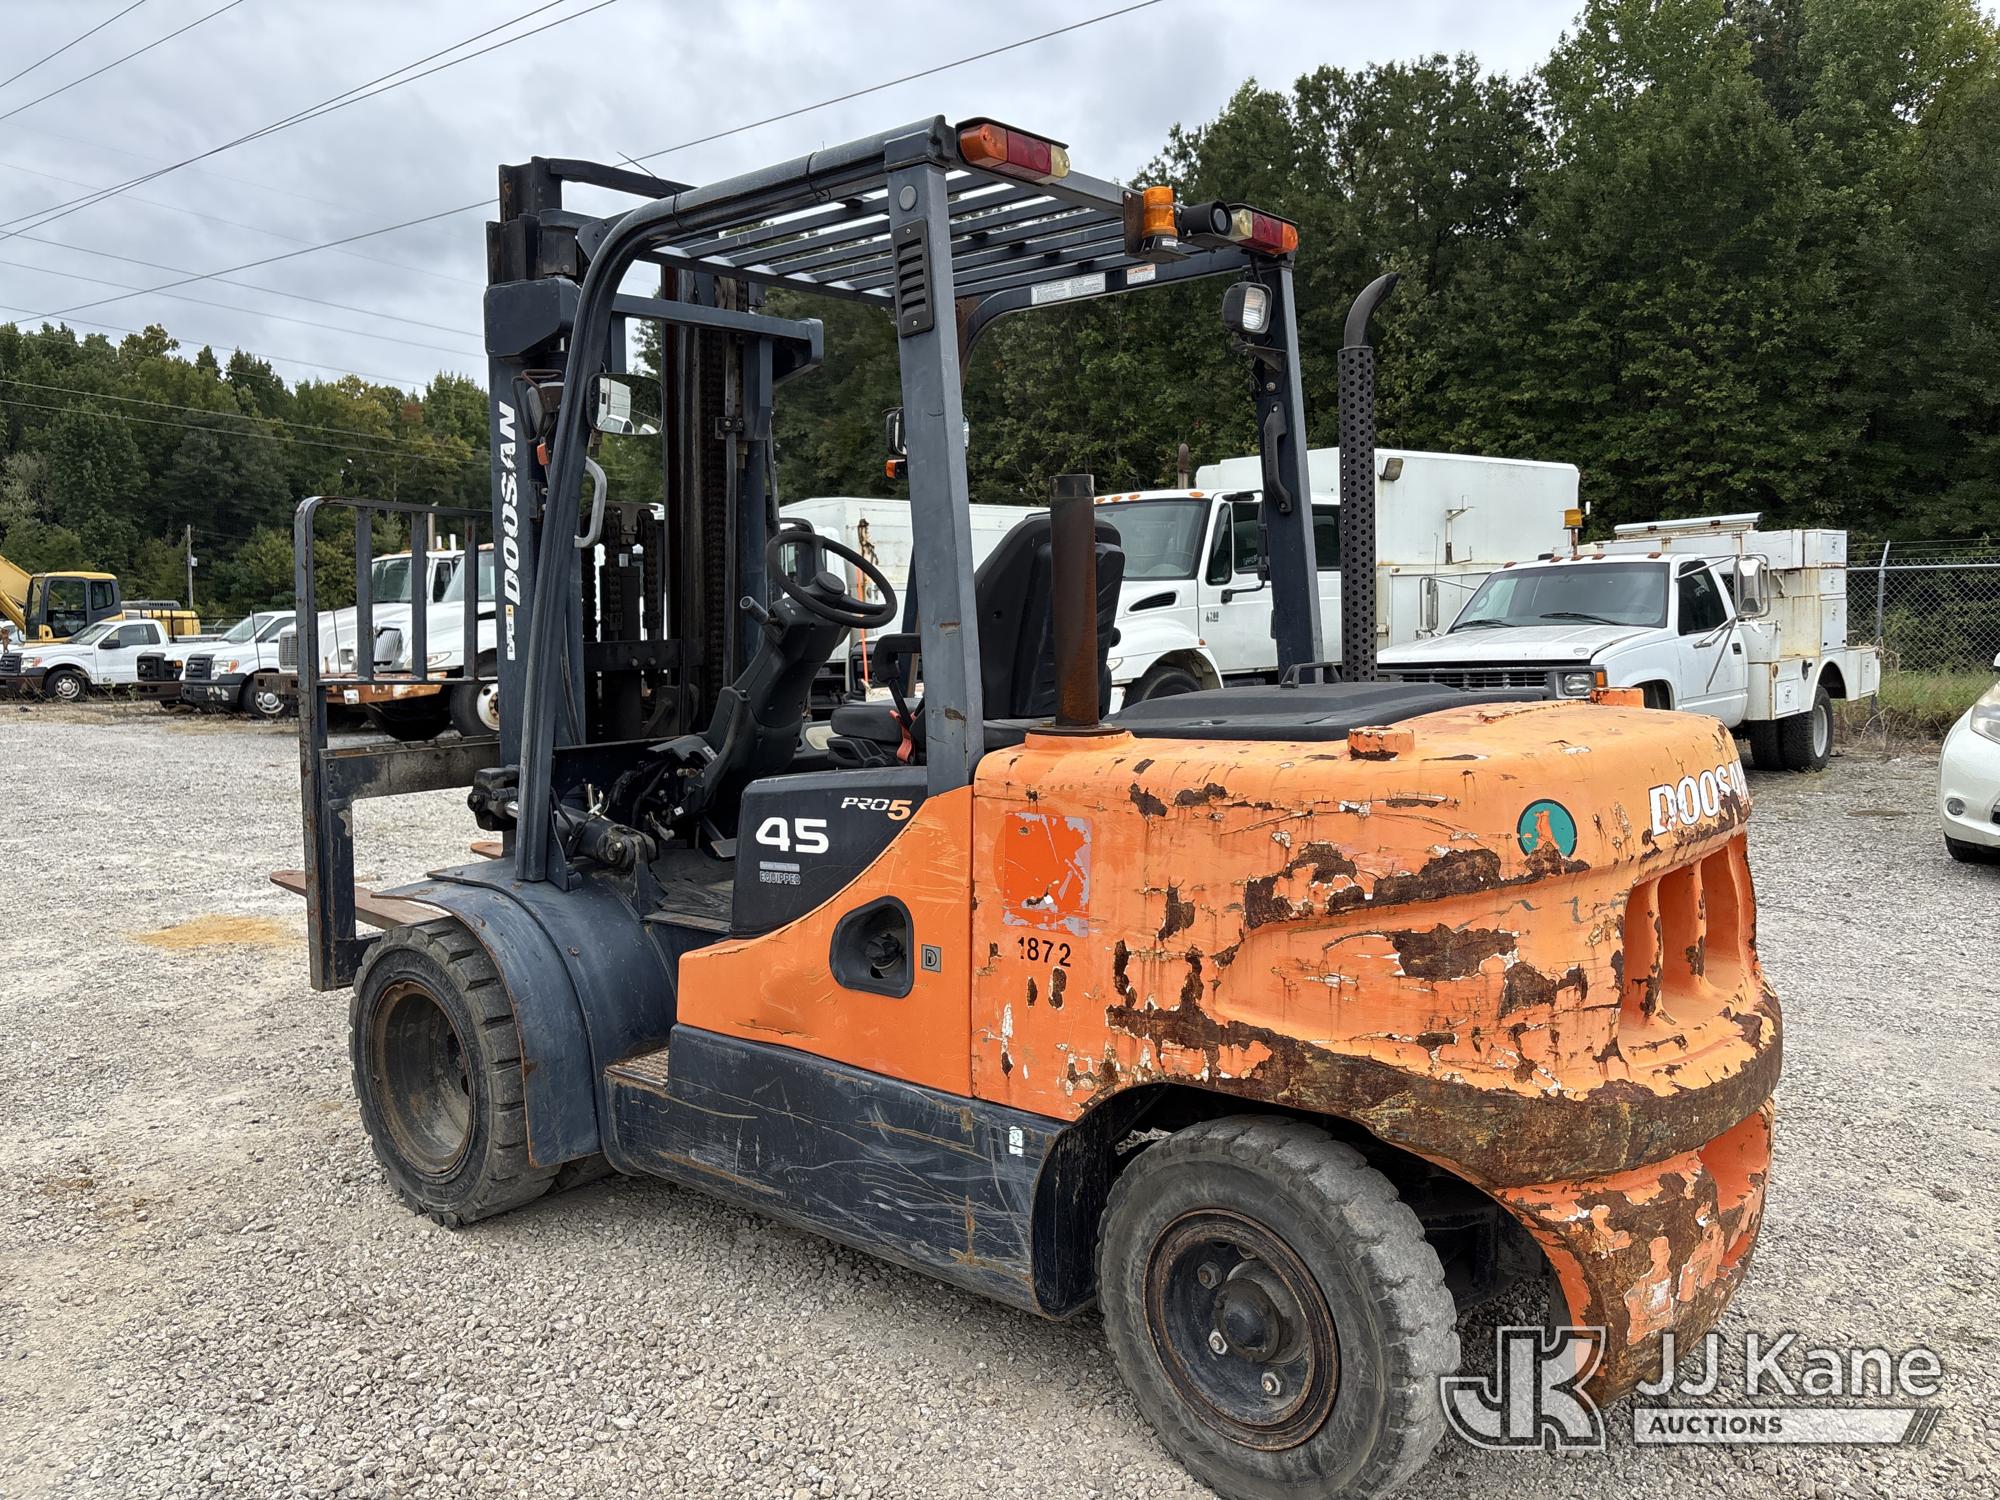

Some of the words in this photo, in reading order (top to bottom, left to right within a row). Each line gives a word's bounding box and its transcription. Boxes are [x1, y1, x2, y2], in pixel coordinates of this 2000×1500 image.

[499, 400, 521, 606] DOOSAN
[755, 816, 830, 854] 45
[759, 870, 801, 886] EQUIPPED
[1018, 936, 1071, 967] 1872
